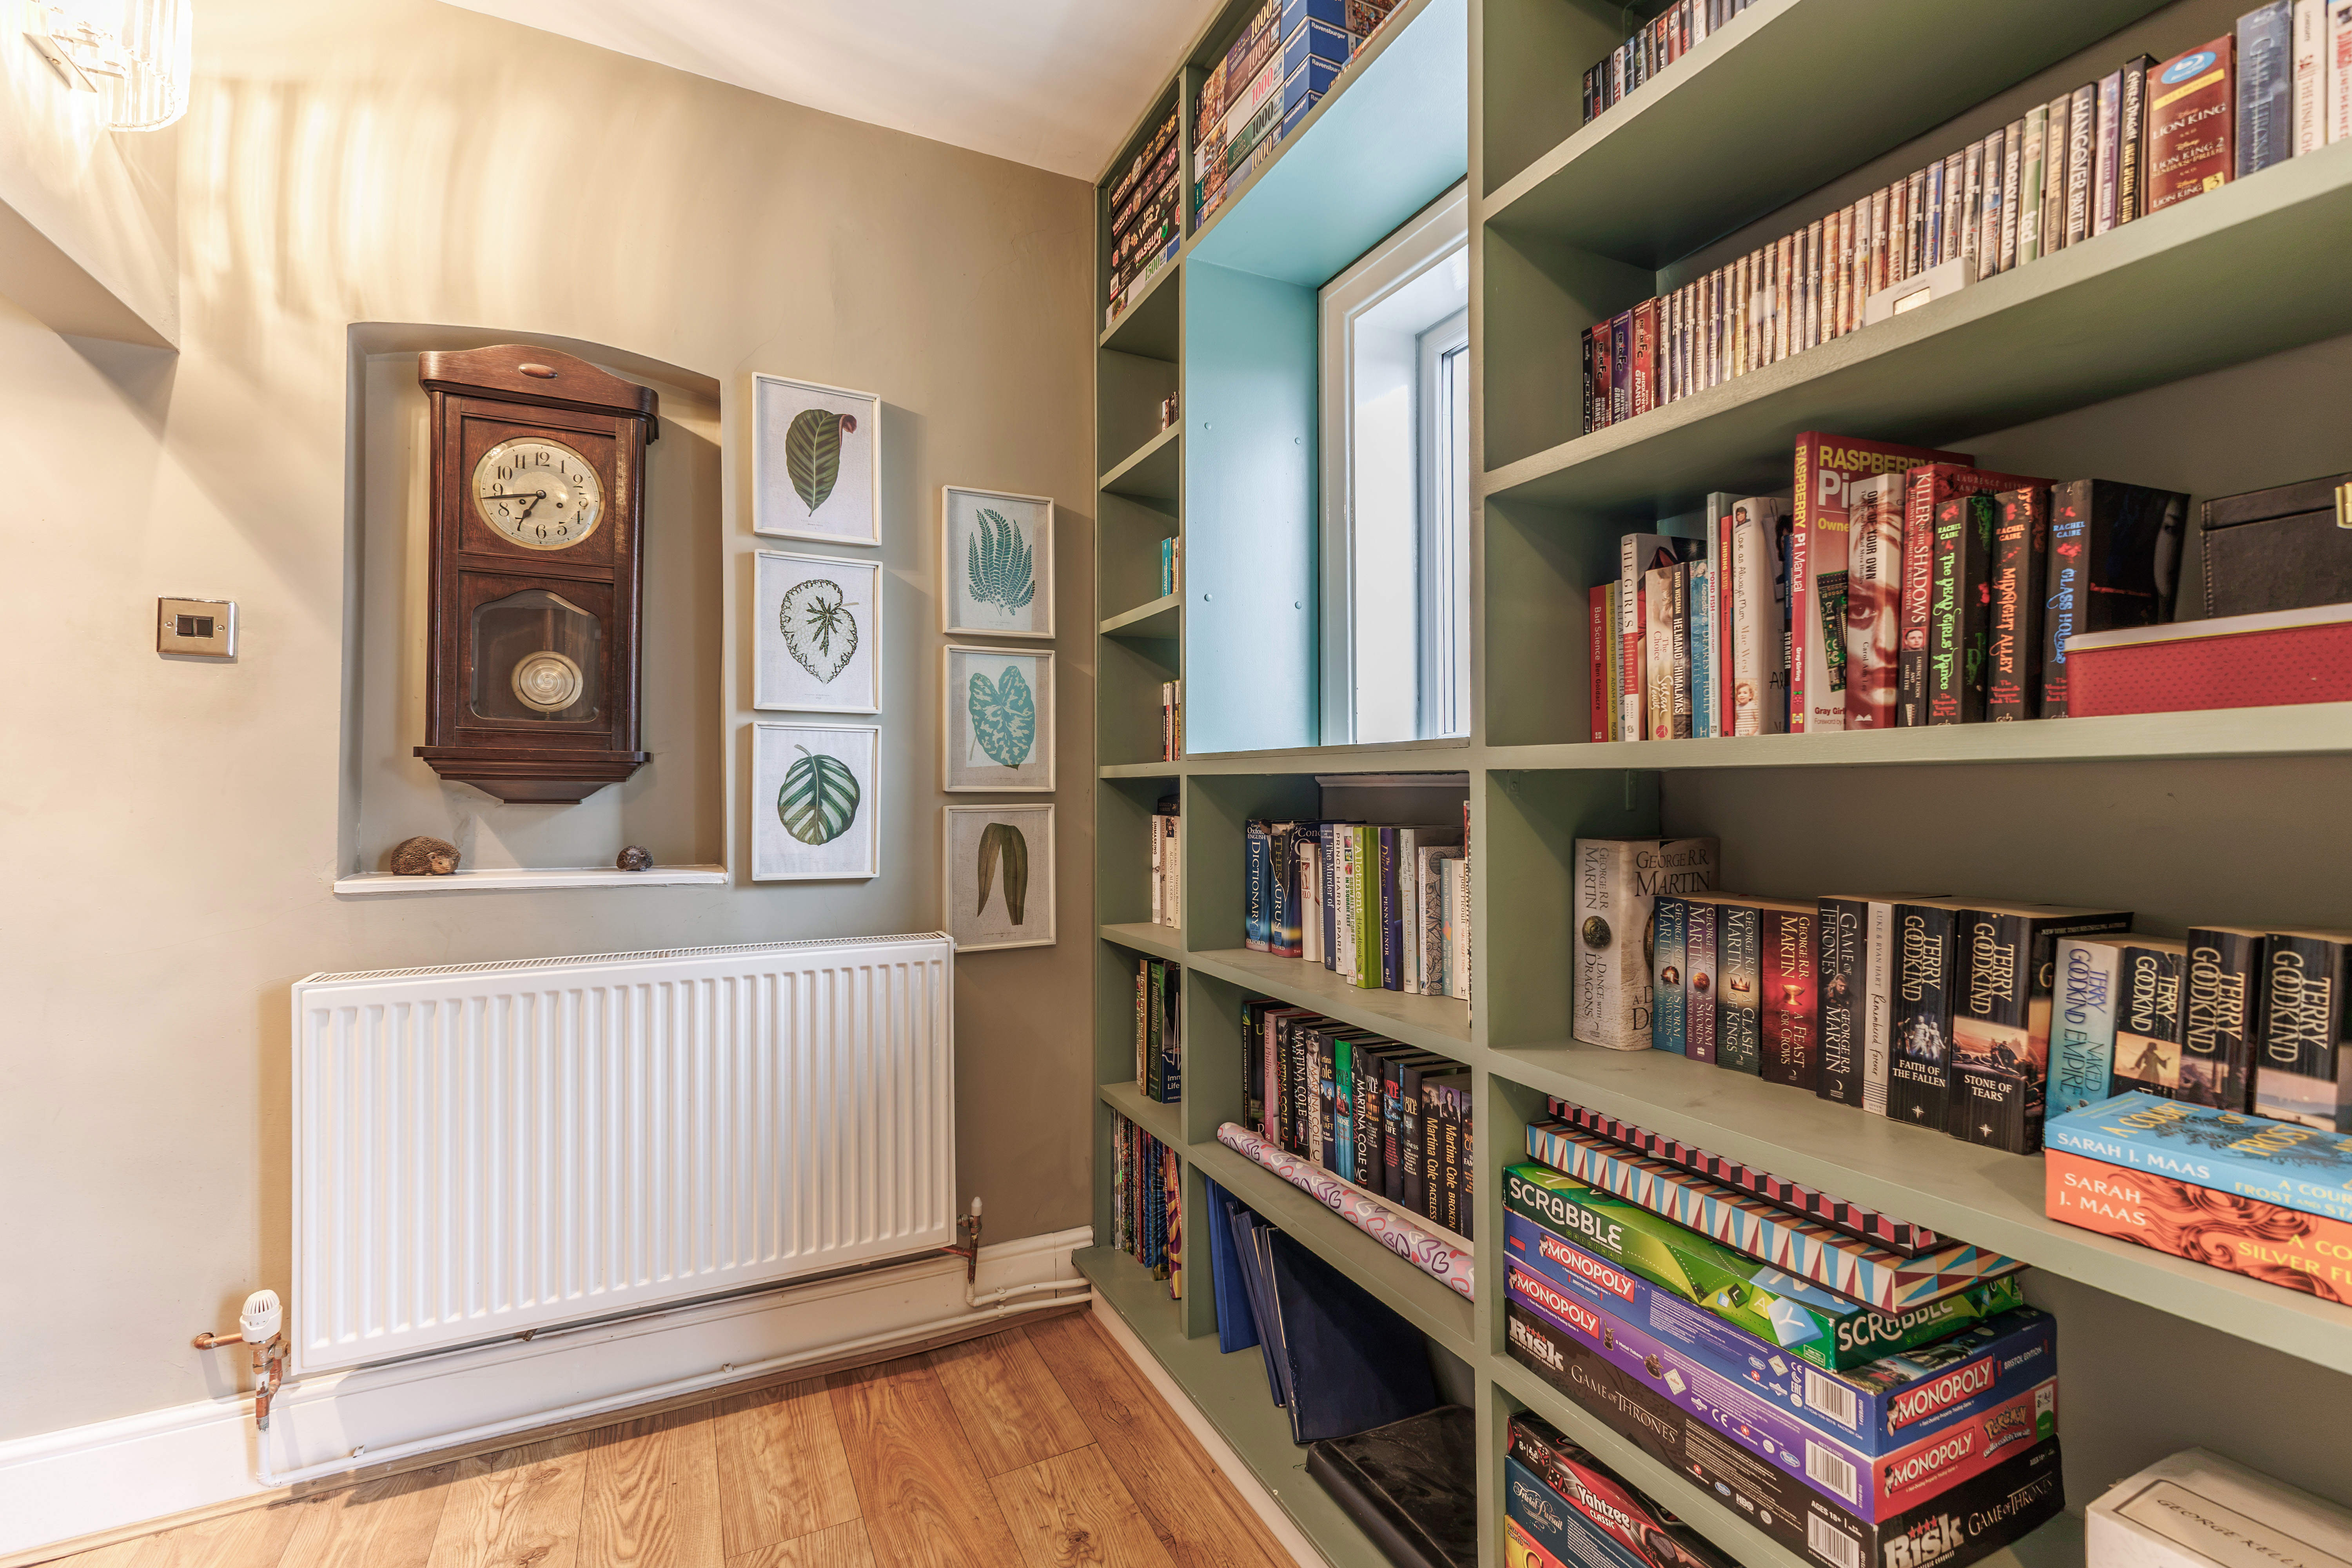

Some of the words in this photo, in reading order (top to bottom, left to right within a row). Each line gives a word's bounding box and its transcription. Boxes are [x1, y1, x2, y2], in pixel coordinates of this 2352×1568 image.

[1251, 0, 1272, 40] 1000
[1312, 22, 1345, 39] Ravensburger
[1285, 25, 1308, 54] Ravensburger
[1251, 67, 1273, 106] 1000
[1285, 60, 1308, 89] Ravensburger
[1252, 101, 1273, 140] 1000
[1252, 123, 1272, 146] Ravensburger
[2152, 117, 2185, 140] LION
[2187, 103, 2227, 125] KING
[2004, 151, 2020, 197] ROCKY
[2101, 181, 2113, 220] FINDING
[2000, 199, 2018, 259] BALBOA
[2020, 210, 2037, 245] ted
[1145, 254, 1160, 281] 1500
[497, 466, 512, 481] 10
[515, 454, 526, 469] 11
[535, 452, 550, 467] 12
[560, 460, 565, 474] 1
[492, 483, 503, 497] 9
[573, 474, 583, 488] 2
[1794, 445, 1807, 529] RASPBERRY
[1817, 469, 1850, 509] Pi
[498, 502, 510, 517] 8
[579, 492, 589, 508] 3
[1866, 490, 1878, 511] ONE
[515, 517, 524, 531] 7
[535, 524, 547, 539] 6
[557, 522, 567, 535] 5
[571, 511, 583, 524] 4
[1867, 512, 1878, 526] OF
[1938, 523, 1962, 533] RACHEL
[1623, 539, 1633, 572] THE
[1866, 527, 1878, 554] YOUR
[1865, 556, 1877, 579] OWN
[1624, 579, 1633, 628] GIRLS
[1653, 631, 1662, 661] Choice
[1673, 618, 1683, 659] HELMAND
[1657, 674, 1673, 717] Susan
[1674, 666, 1684, 714] HIMALAYAS
[1326, 843, 1334, 860] The
[1252, 841, 1260, 927] DICTIONARY
[1355, 844, 1363, 913] Allotment
[1634, 870, 1710, 897] MARTIN
[1301, 891, 1310, 899] POLO
[1327, 898, 1334, 908] of
[1706, 907, 1715, 950] GEORGE
[1820, 905, 1839, 975] THRONES
[1902, 915, 1925, 1002] GOODKIND
[1922, 935, 1942, 991] TERRY
[1584, 952, 1597, 1016] DRAGONS
[1595, 962, 1607, 999] DANCE
[1731, 991, 1738, 1009] OF
[1665, 996, 1673, 1035] SWORDS
[1726, 1010, 1740, 1053] KINGS
[1741, 1007, 1755, 1056] CLASH
[1792, 1025, 1807, 1068] FEAST
[1295, 1030, 1305, 1085] MARTINA
[1899, 1059, 1926, 1073] FAITH
[1927, 1065, 1940, 1076] OF
[2059, 1028, 2088, 1096] EMPIRE
[2083, 1040, 2105, 1093] NAKED
[1892, 1068, 1911, 1079] THE
[1912, 1072, 1946, 1088] FALLEN
[1964, 1074, 1996, 1089] STONE
[1998, 1082, 2013, 1093] OF
[1297, 1086, 1307, 1116] COLE
[1971, 1086, 2004, 1102] TEARS
[1385, 1126, 1396, 1135] LIFE
[1427, 1117, 1438, 1154] Martina
[1427, 1159, 1438, 1180] Cole
[2063, 1173, 2141, 1205] SARAH
[1510, 1177, 1622, 1251] SCRABBLE
[2060, 1191, 2071, 1206] J.
[2079, 1196, 2147, 1227] MAAS
[1566, 1229, 1622, 1263] ORIGINAL
[2238, 1242, 2321, 1276] SILVER
[1548, 1240, 1632, 1296] MONOPOLY
[1573, 1279, 1584, 1290] BRISTOL
[1584, 1285, 1598, 1296] EDITION
[1619, 1341, 1629, 1352] Metal
[1629, 1347, 1643, 1359] Tokens
[1571, 1364, 1607, 1399] GAME
[1608, 1392, 1618, 1404] OF
[1615, 1390, 1678, 1444] THRONES
[1519, 1441, 1526, 1450] 8+
[1576, 1485, 1630, 1528] Yahtzee
[1735, 1493, 1754, 1512] HBO
[1811, 1500, 1828, 1516] AGES
[1829, 1512, 1842, 1523] 18+
[1590, 1510, 1615, 1530] CLASSIC
[1518, 1531, 1530, 1546] Players
